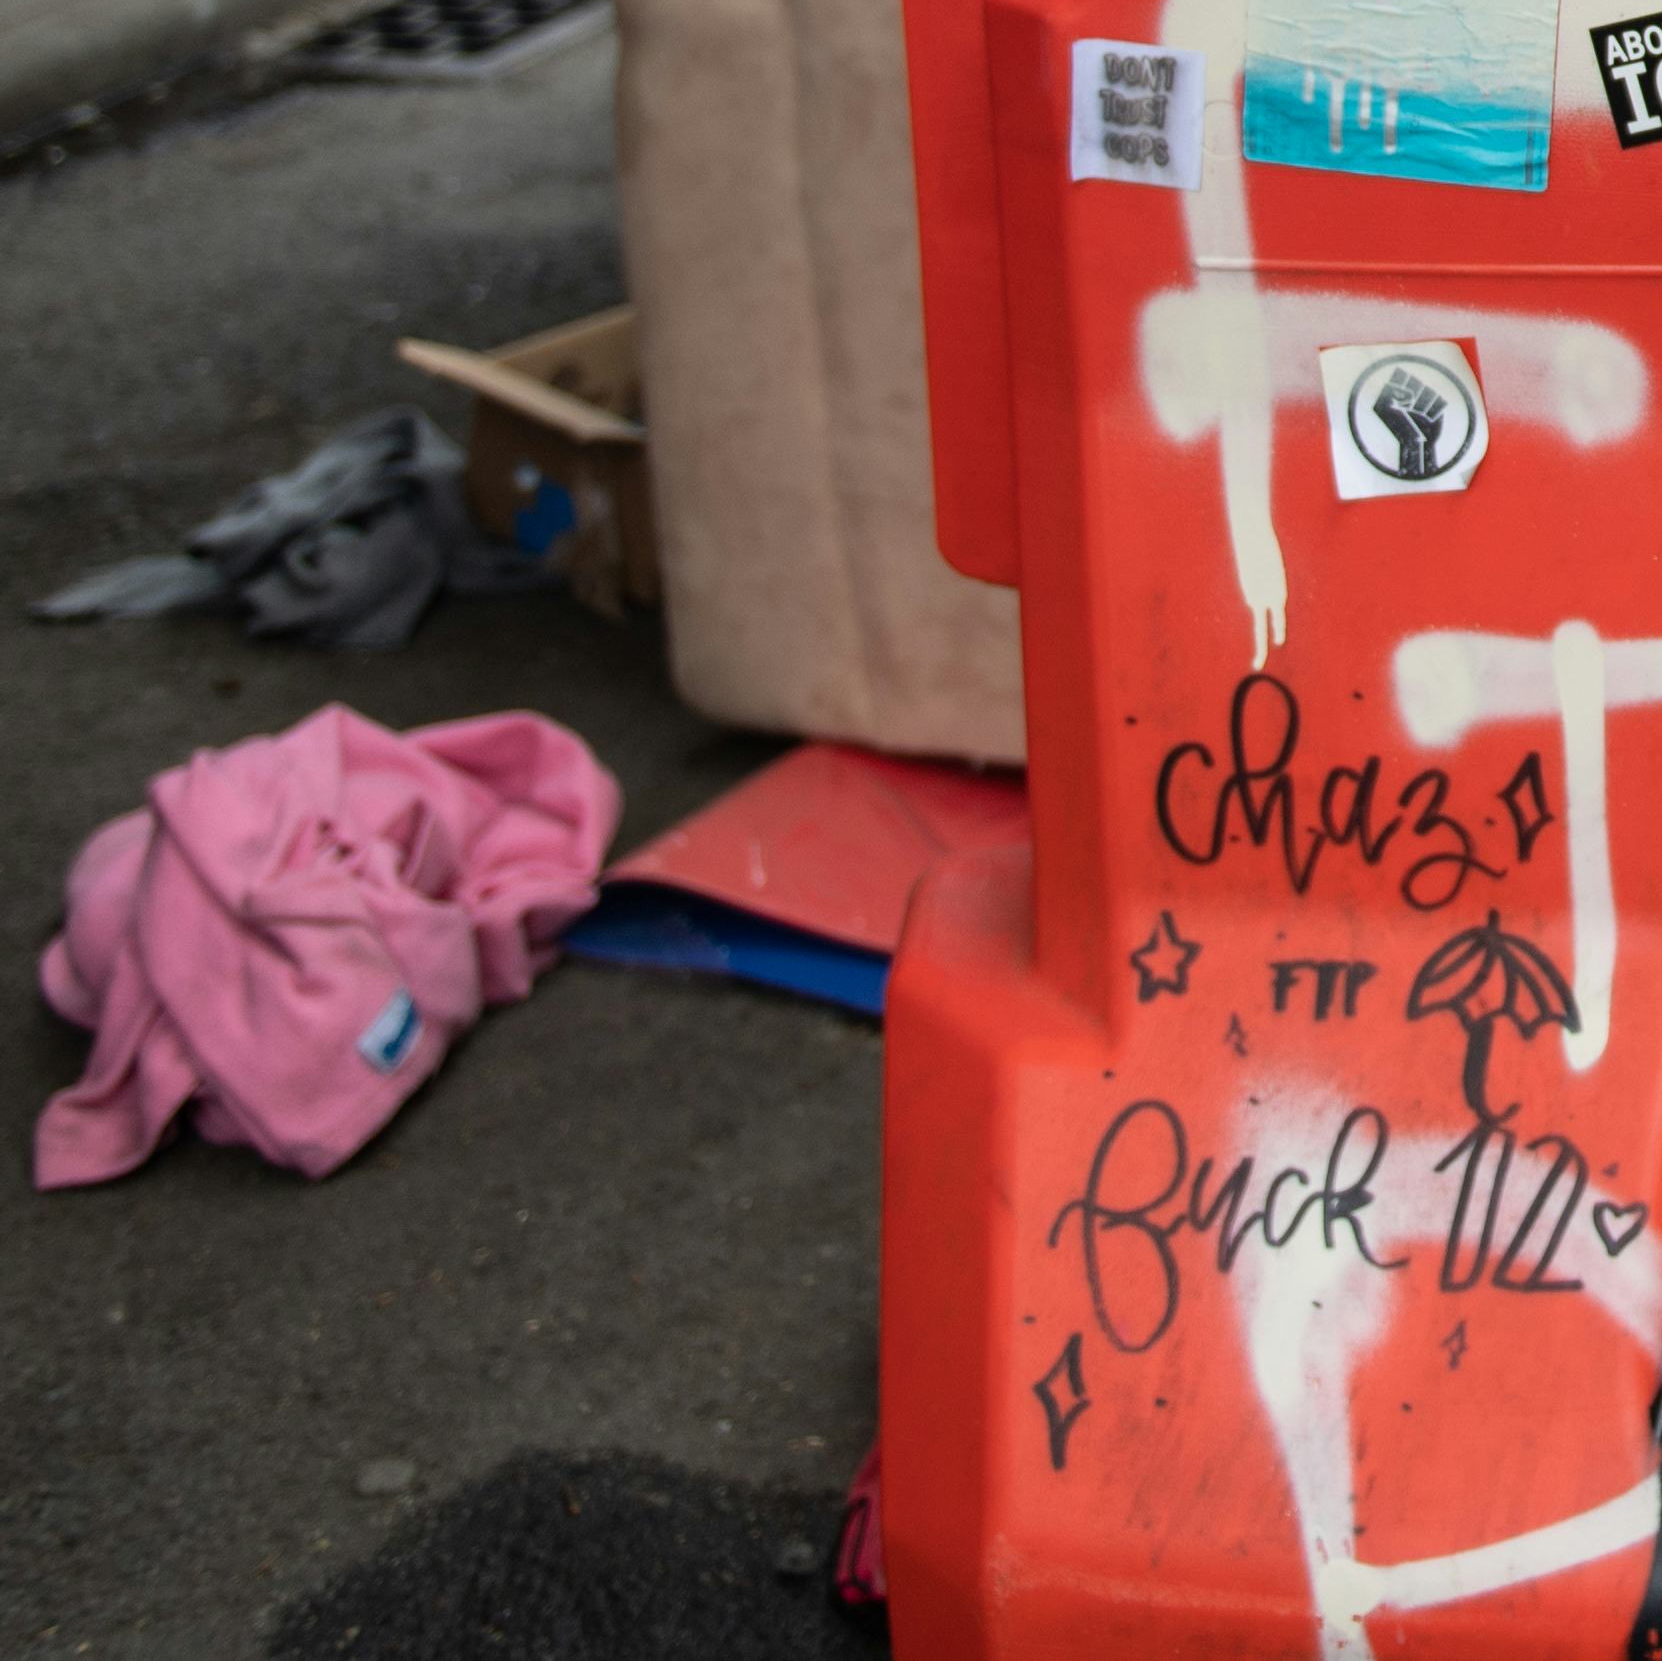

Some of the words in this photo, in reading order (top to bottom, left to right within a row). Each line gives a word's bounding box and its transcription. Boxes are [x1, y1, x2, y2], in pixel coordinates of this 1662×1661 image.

[1099, 88, 1168, 130] TRUST
[1103, 132, 1169, 167] COPS
[1268, 959, 1378, 1023] FTP
